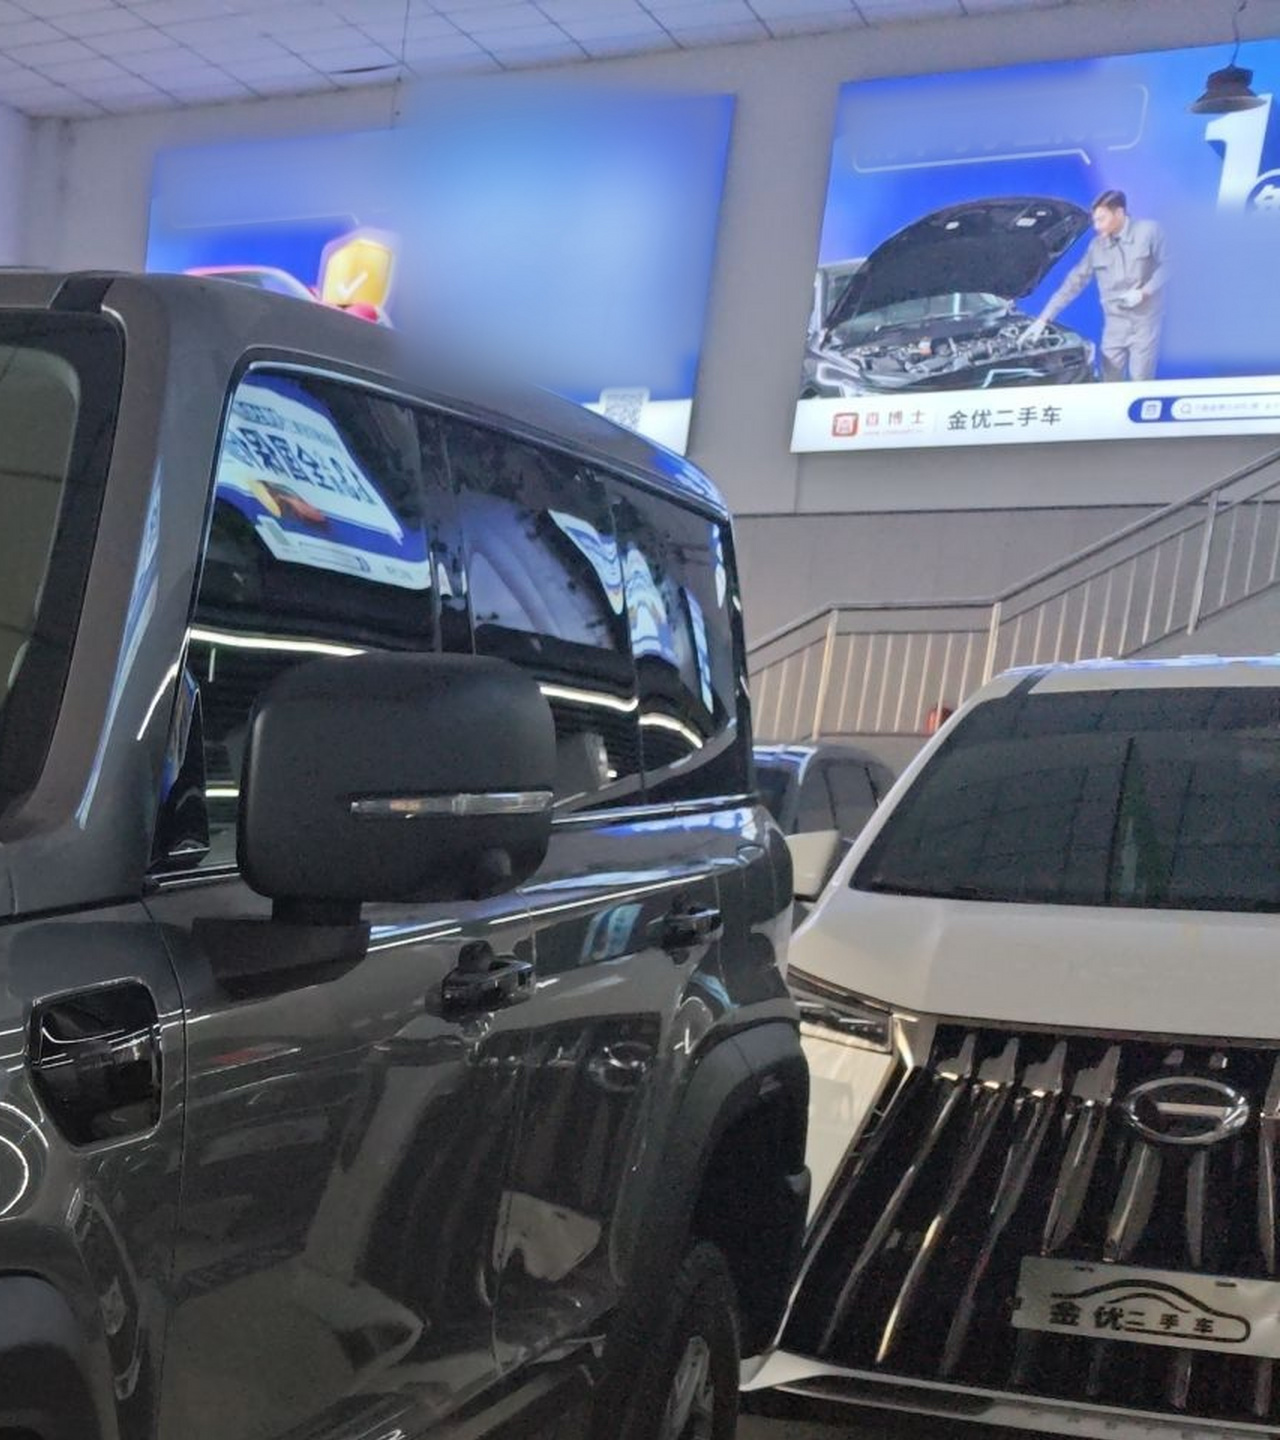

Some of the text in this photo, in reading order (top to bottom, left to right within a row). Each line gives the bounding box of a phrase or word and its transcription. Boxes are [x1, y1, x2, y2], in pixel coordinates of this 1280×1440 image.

[947, 404, 1062, 431] 金优二手车
[1048, 1300, 1214, 1335] 金优二手车
